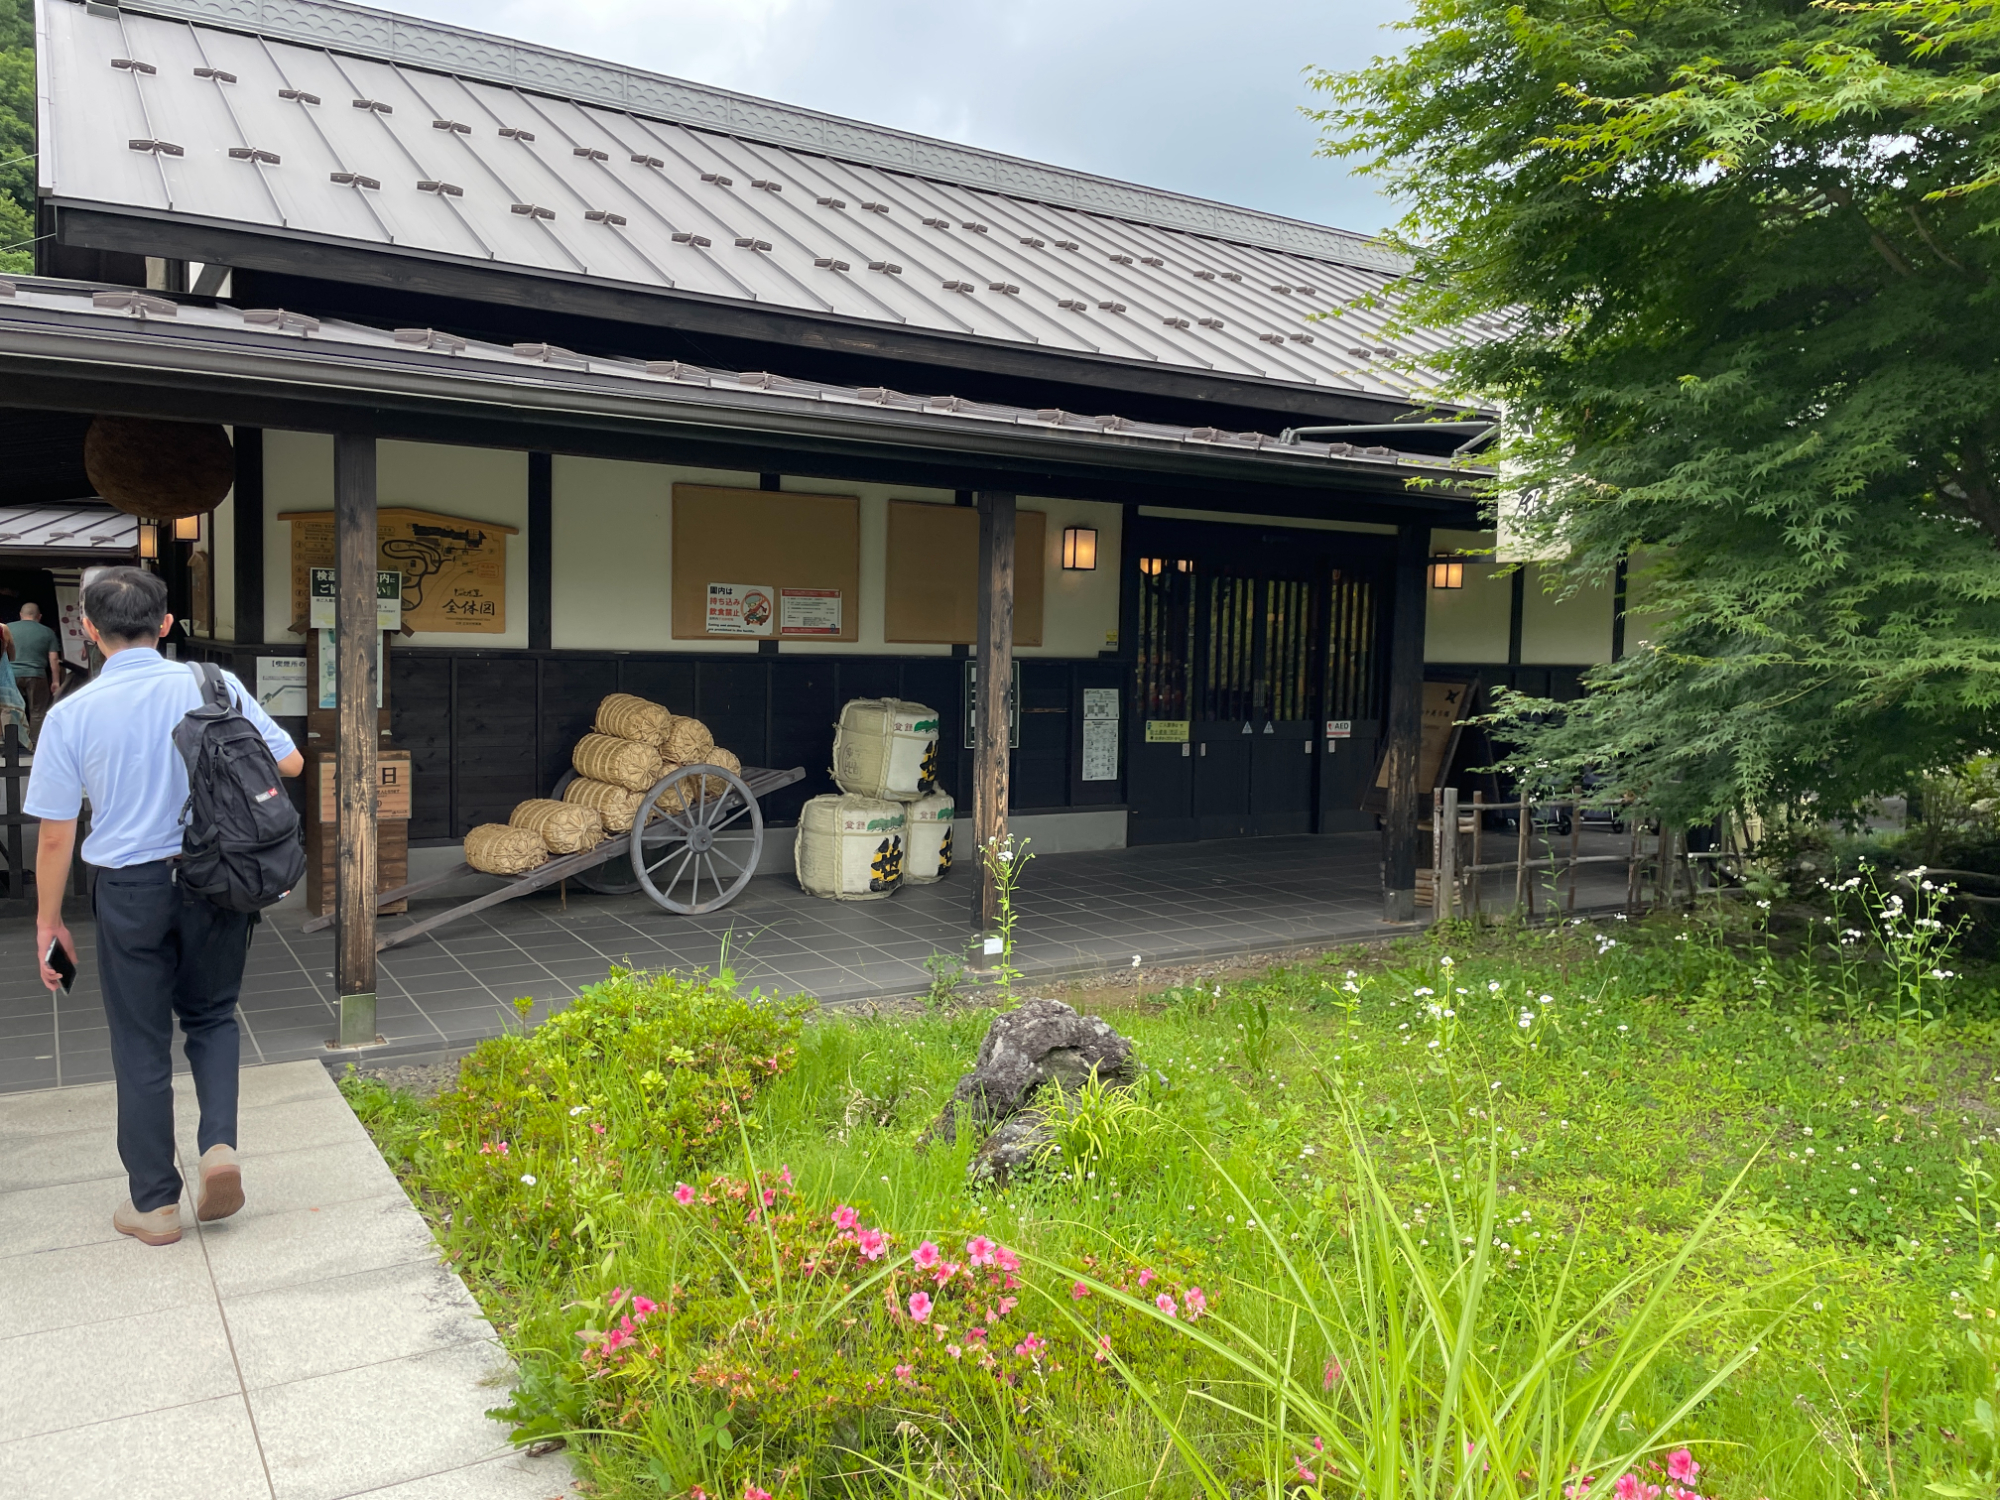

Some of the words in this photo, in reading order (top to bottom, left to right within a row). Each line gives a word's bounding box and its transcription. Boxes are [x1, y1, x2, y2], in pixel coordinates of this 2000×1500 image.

[709, 597, 740, 606] 持ち込み
[442, 599, 495, 616] 全体図
[709, 608, 740, 617] 飲食禁止
[1334, 722, 1349, 730] AED
